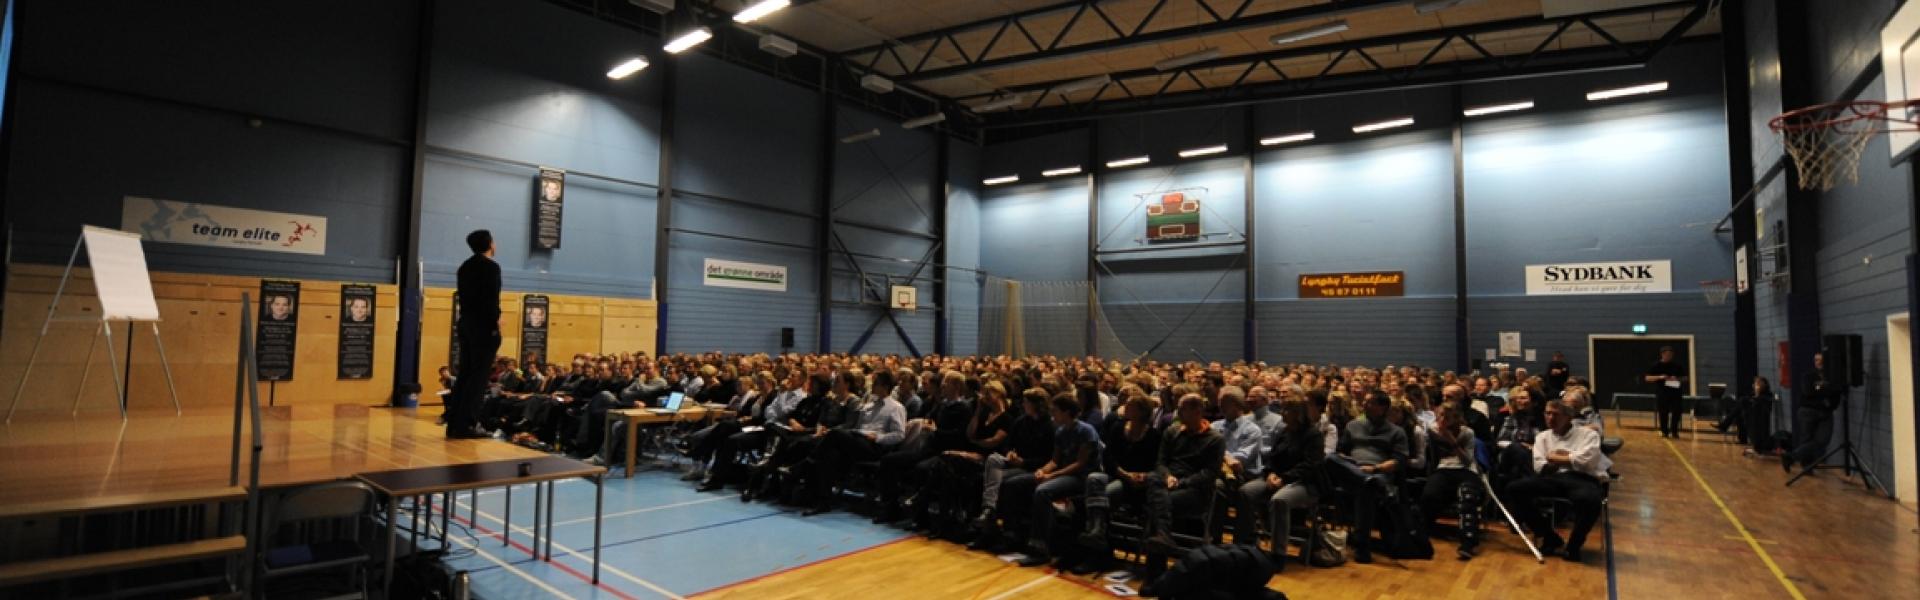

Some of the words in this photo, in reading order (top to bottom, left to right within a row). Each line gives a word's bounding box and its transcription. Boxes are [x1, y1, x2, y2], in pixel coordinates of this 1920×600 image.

[192, 223, 238, 238] team
[242, 228, 281, 241] elite
[706, 264, 721, 274] det
[1544, 265, 1653, 281] SYDBANK
[1302, 276, 1341, 287] Lyngby
